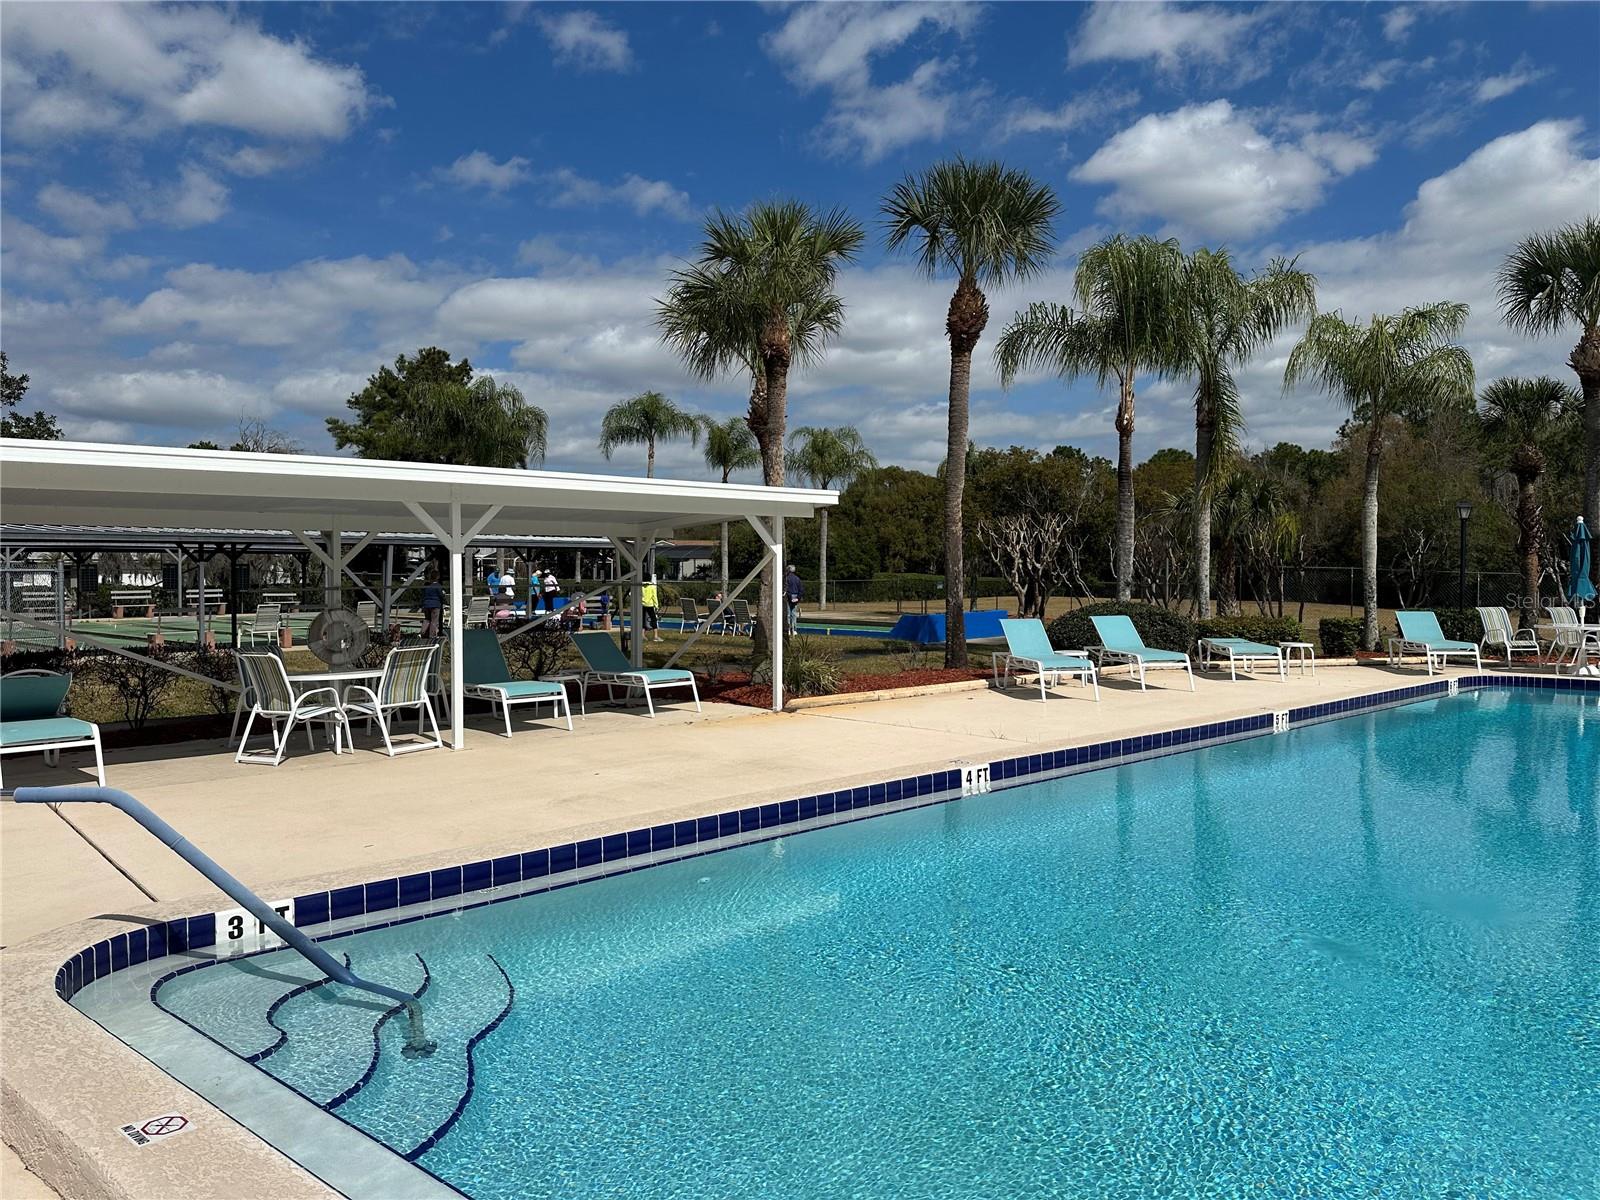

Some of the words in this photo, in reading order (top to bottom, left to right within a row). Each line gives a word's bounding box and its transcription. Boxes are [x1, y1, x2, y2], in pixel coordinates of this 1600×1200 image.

[1275, 714, 1280, 726] 5
[966, 770, 973, 785] 4
[228, 915, 244, 940] 3
